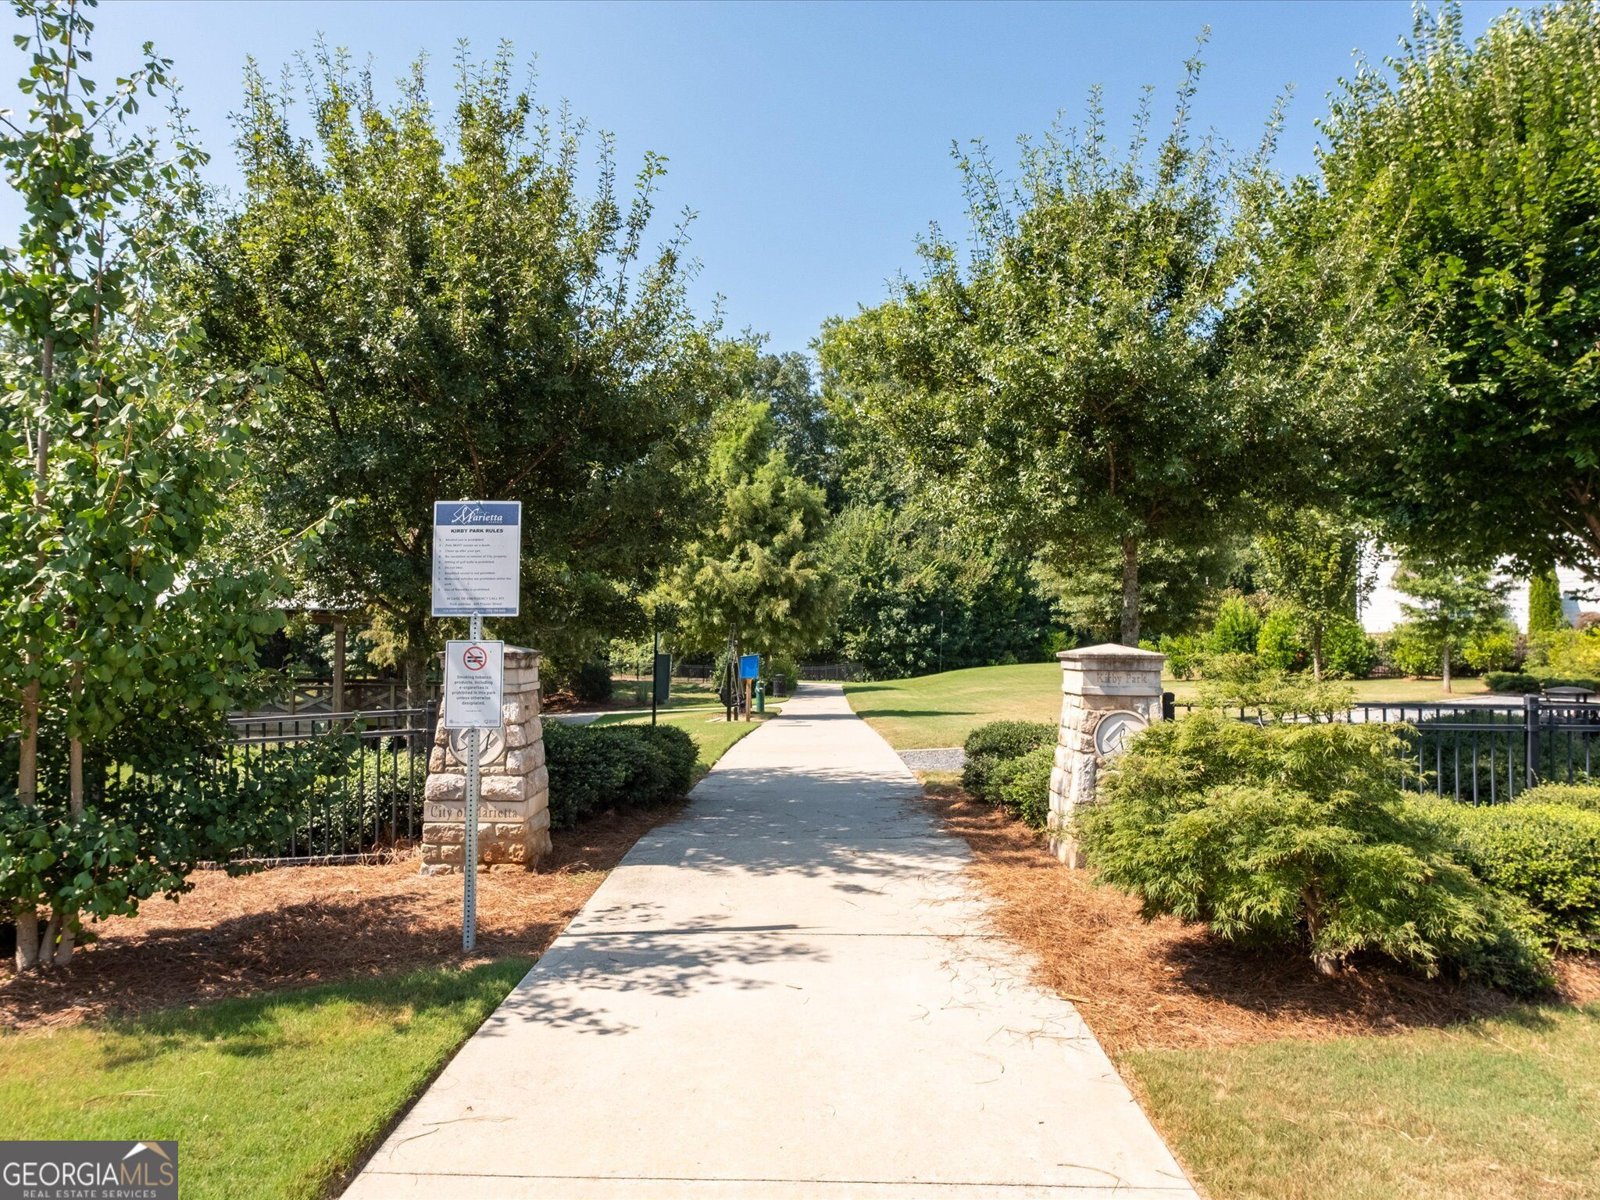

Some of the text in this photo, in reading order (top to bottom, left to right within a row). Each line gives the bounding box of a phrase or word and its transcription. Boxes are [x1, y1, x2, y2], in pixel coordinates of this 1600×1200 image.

[452, 507, 503, 523] Marietta
[1096, 671, 1148, 685] Kirby Park
[430, 806, 452, 821] City
